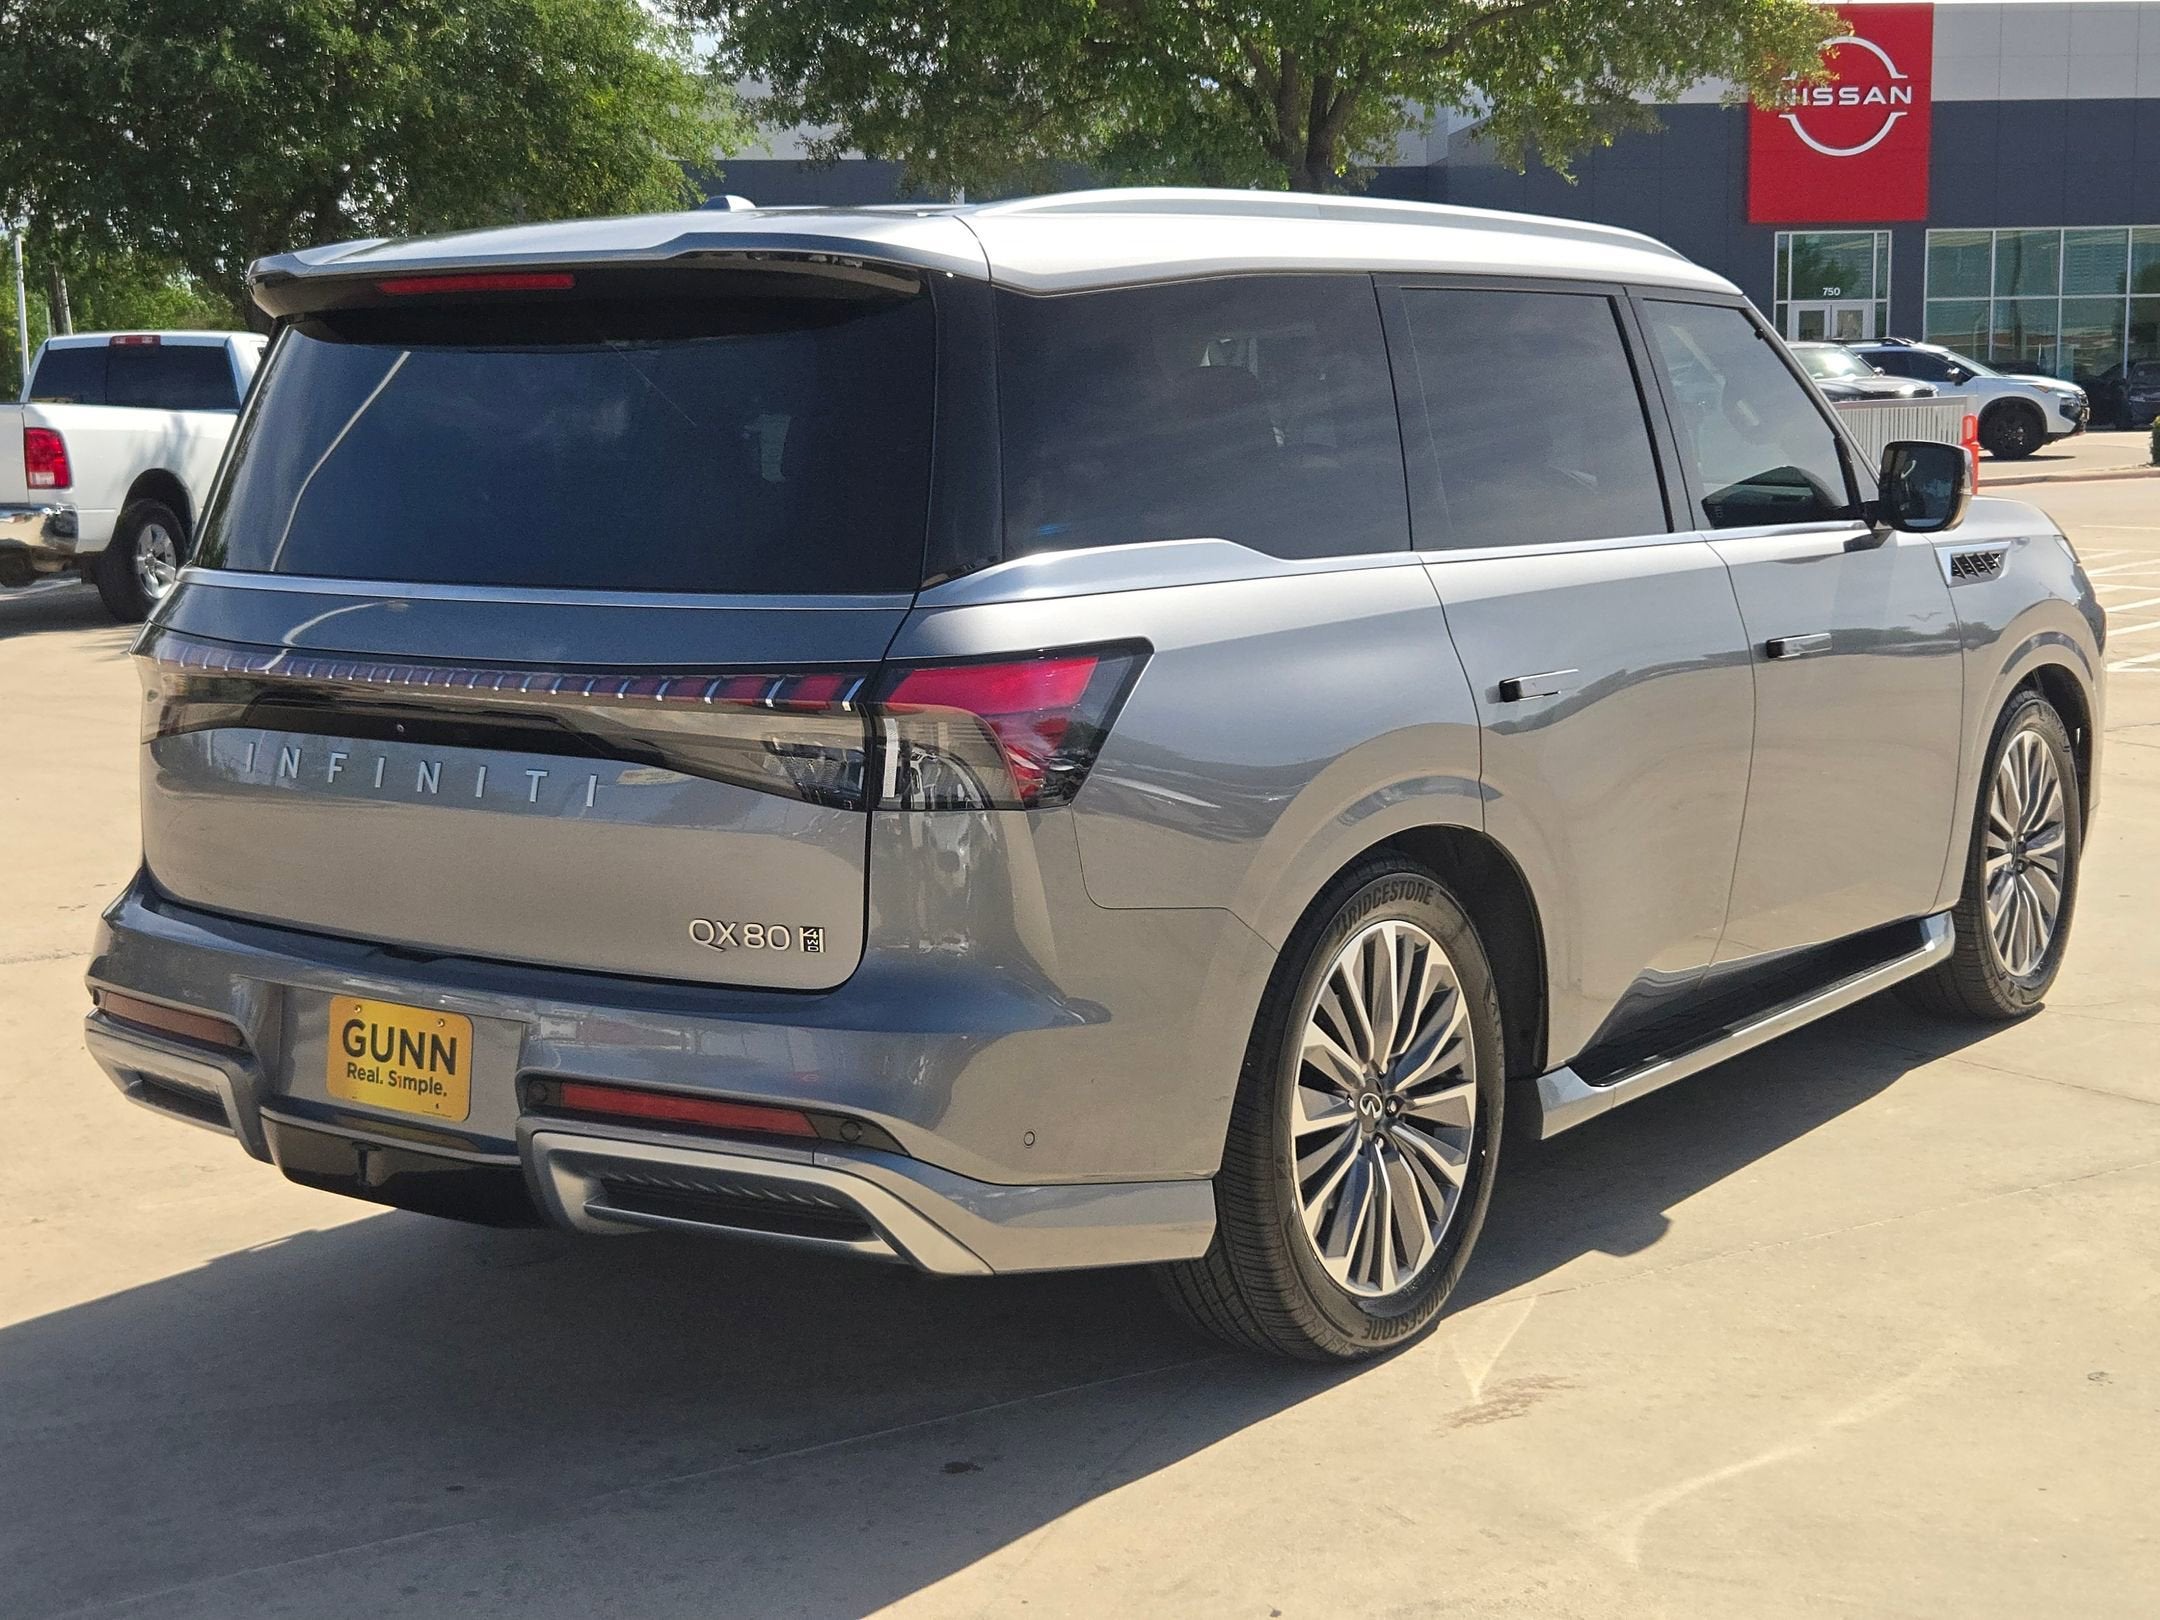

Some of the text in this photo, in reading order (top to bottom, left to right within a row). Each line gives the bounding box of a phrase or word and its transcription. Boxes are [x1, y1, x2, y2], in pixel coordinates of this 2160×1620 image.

[1822, 287, 1841, 296] 750
[244, 742, 600, 807] INFINITI
[688, 918, 792, 951] QX80
[342, 1018, 457, 1075] GUNN
[346, 1062, 384, 1085] Real.
